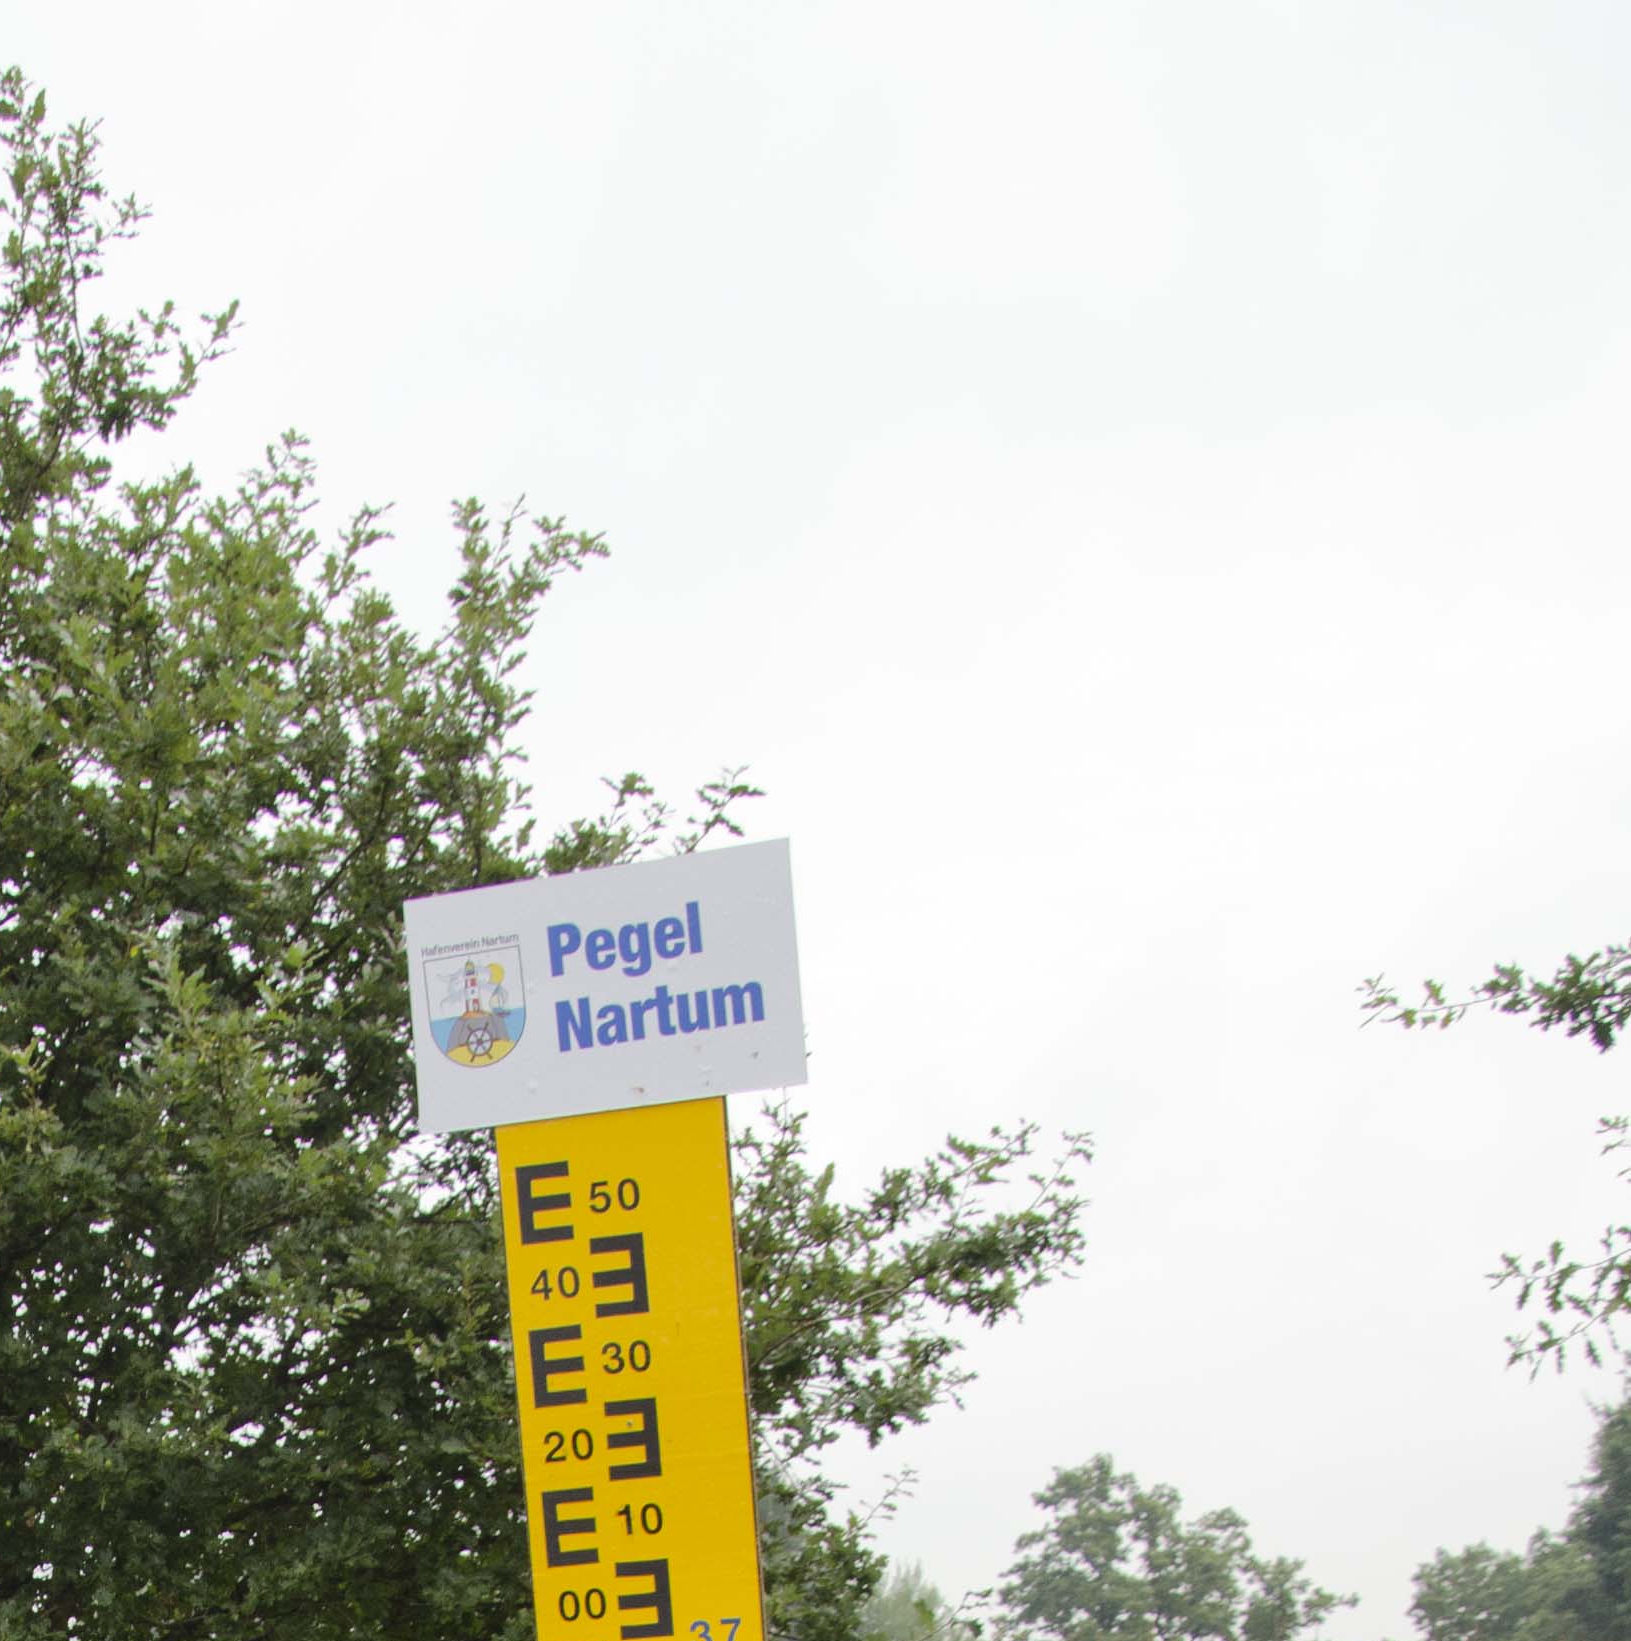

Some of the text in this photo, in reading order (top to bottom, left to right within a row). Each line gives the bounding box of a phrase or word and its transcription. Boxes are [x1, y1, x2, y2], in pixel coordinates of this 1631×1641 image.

[420, 933, 520, 958] Hafenverein Nartum
[547, 900, 704, 977] Pegel
[556, 981, 766, 1053] Nartum
[589, 1177, 641, 1213] 50
[531, 1266, 581, 1300] 40
[602, 1339, 652, 1374] 30
[543, 1428, 594, 1463] 20
[616, 1502, 664, 1536] 10
[558, 1587, 608, 1622] 00
